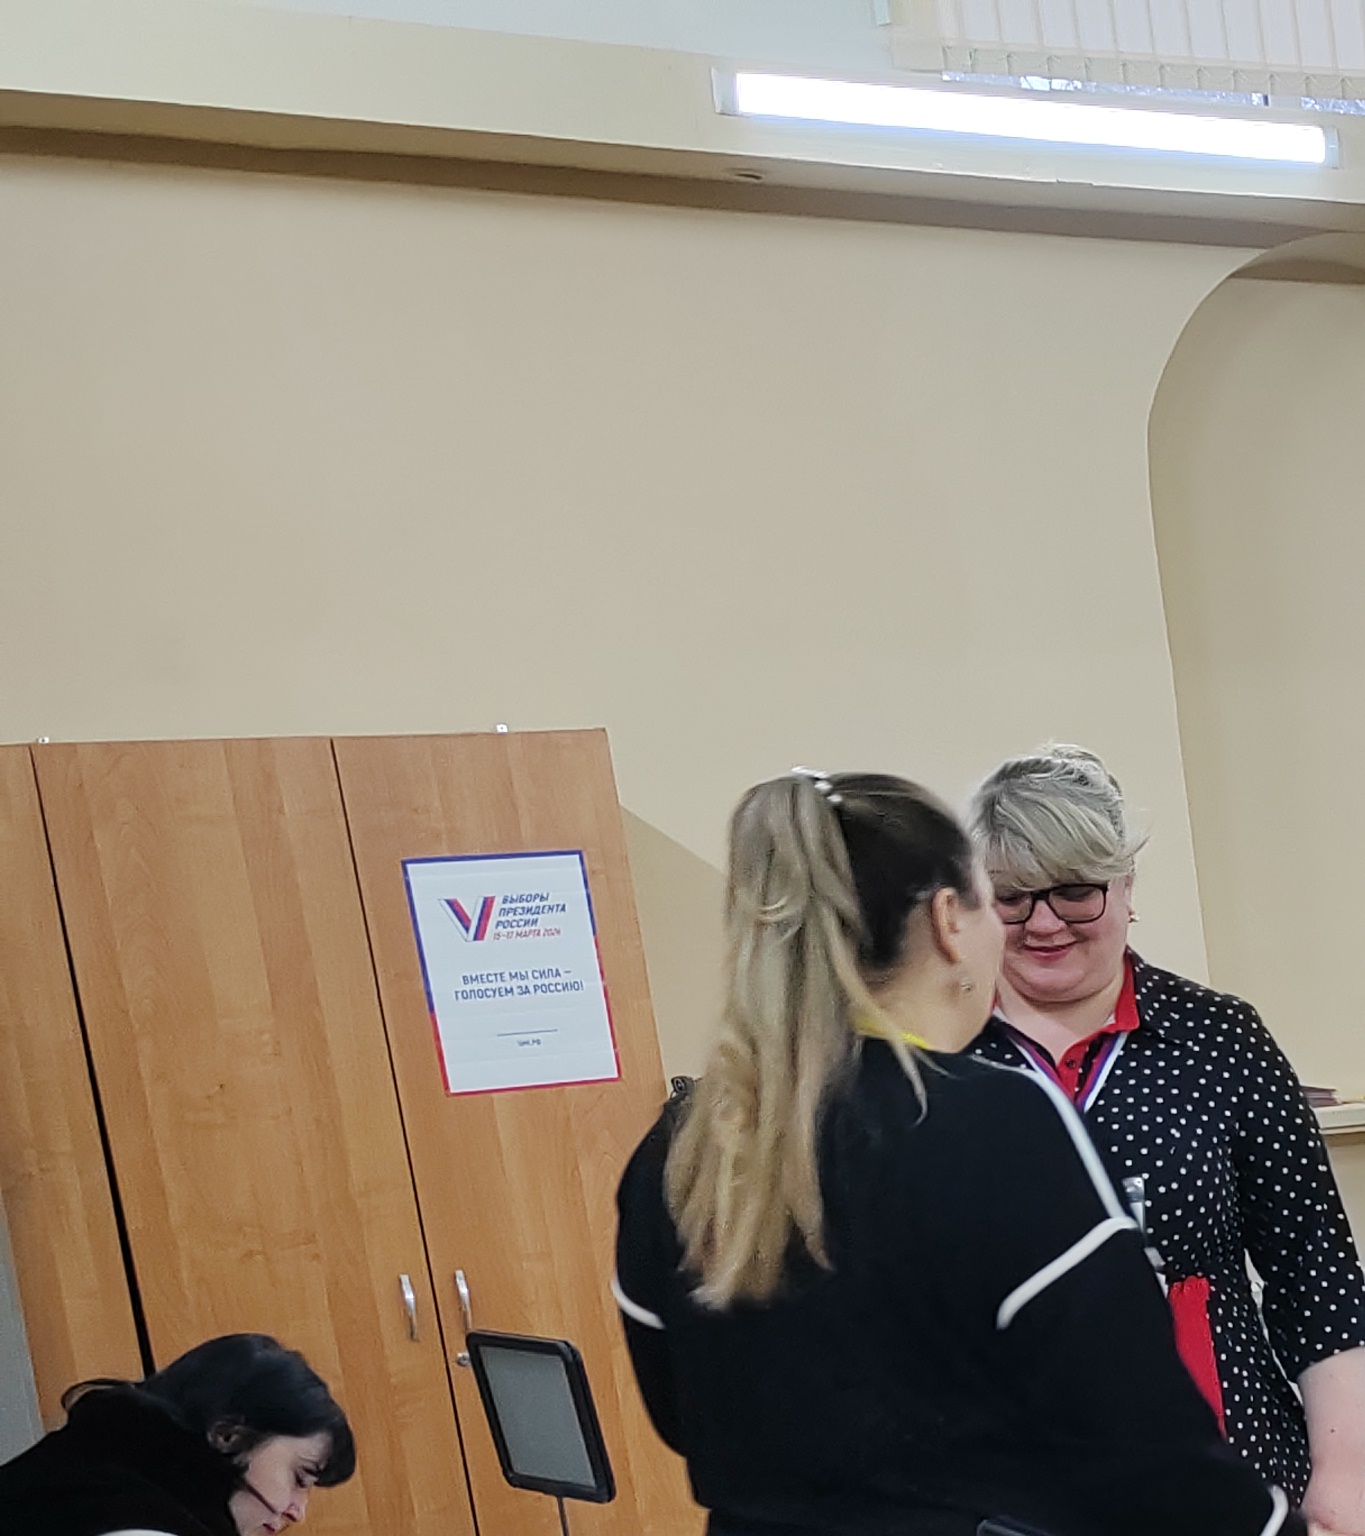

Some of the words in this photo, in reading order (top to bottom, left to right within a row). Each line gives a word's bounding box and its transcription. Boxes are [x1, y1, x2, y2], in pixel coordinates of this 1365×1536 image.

[502, 892, 549, 904] ВЫБОРЫ
[498, 903, 566, 917] ПРЕЗИДЕНТА
[495, 918, 538, 929] РОССИИ
[462, 972, 506, 985] ВМЕСТЕ
[509, 970, 529, 982] МЫ
[531, 968, 562, 980] СИЛА
[455, 986, 514, 1001] ГОЛОСУЕМ
[517, 985, 530, 996] ЗА
[533, 980, 584, 995] РОССИЮ!
